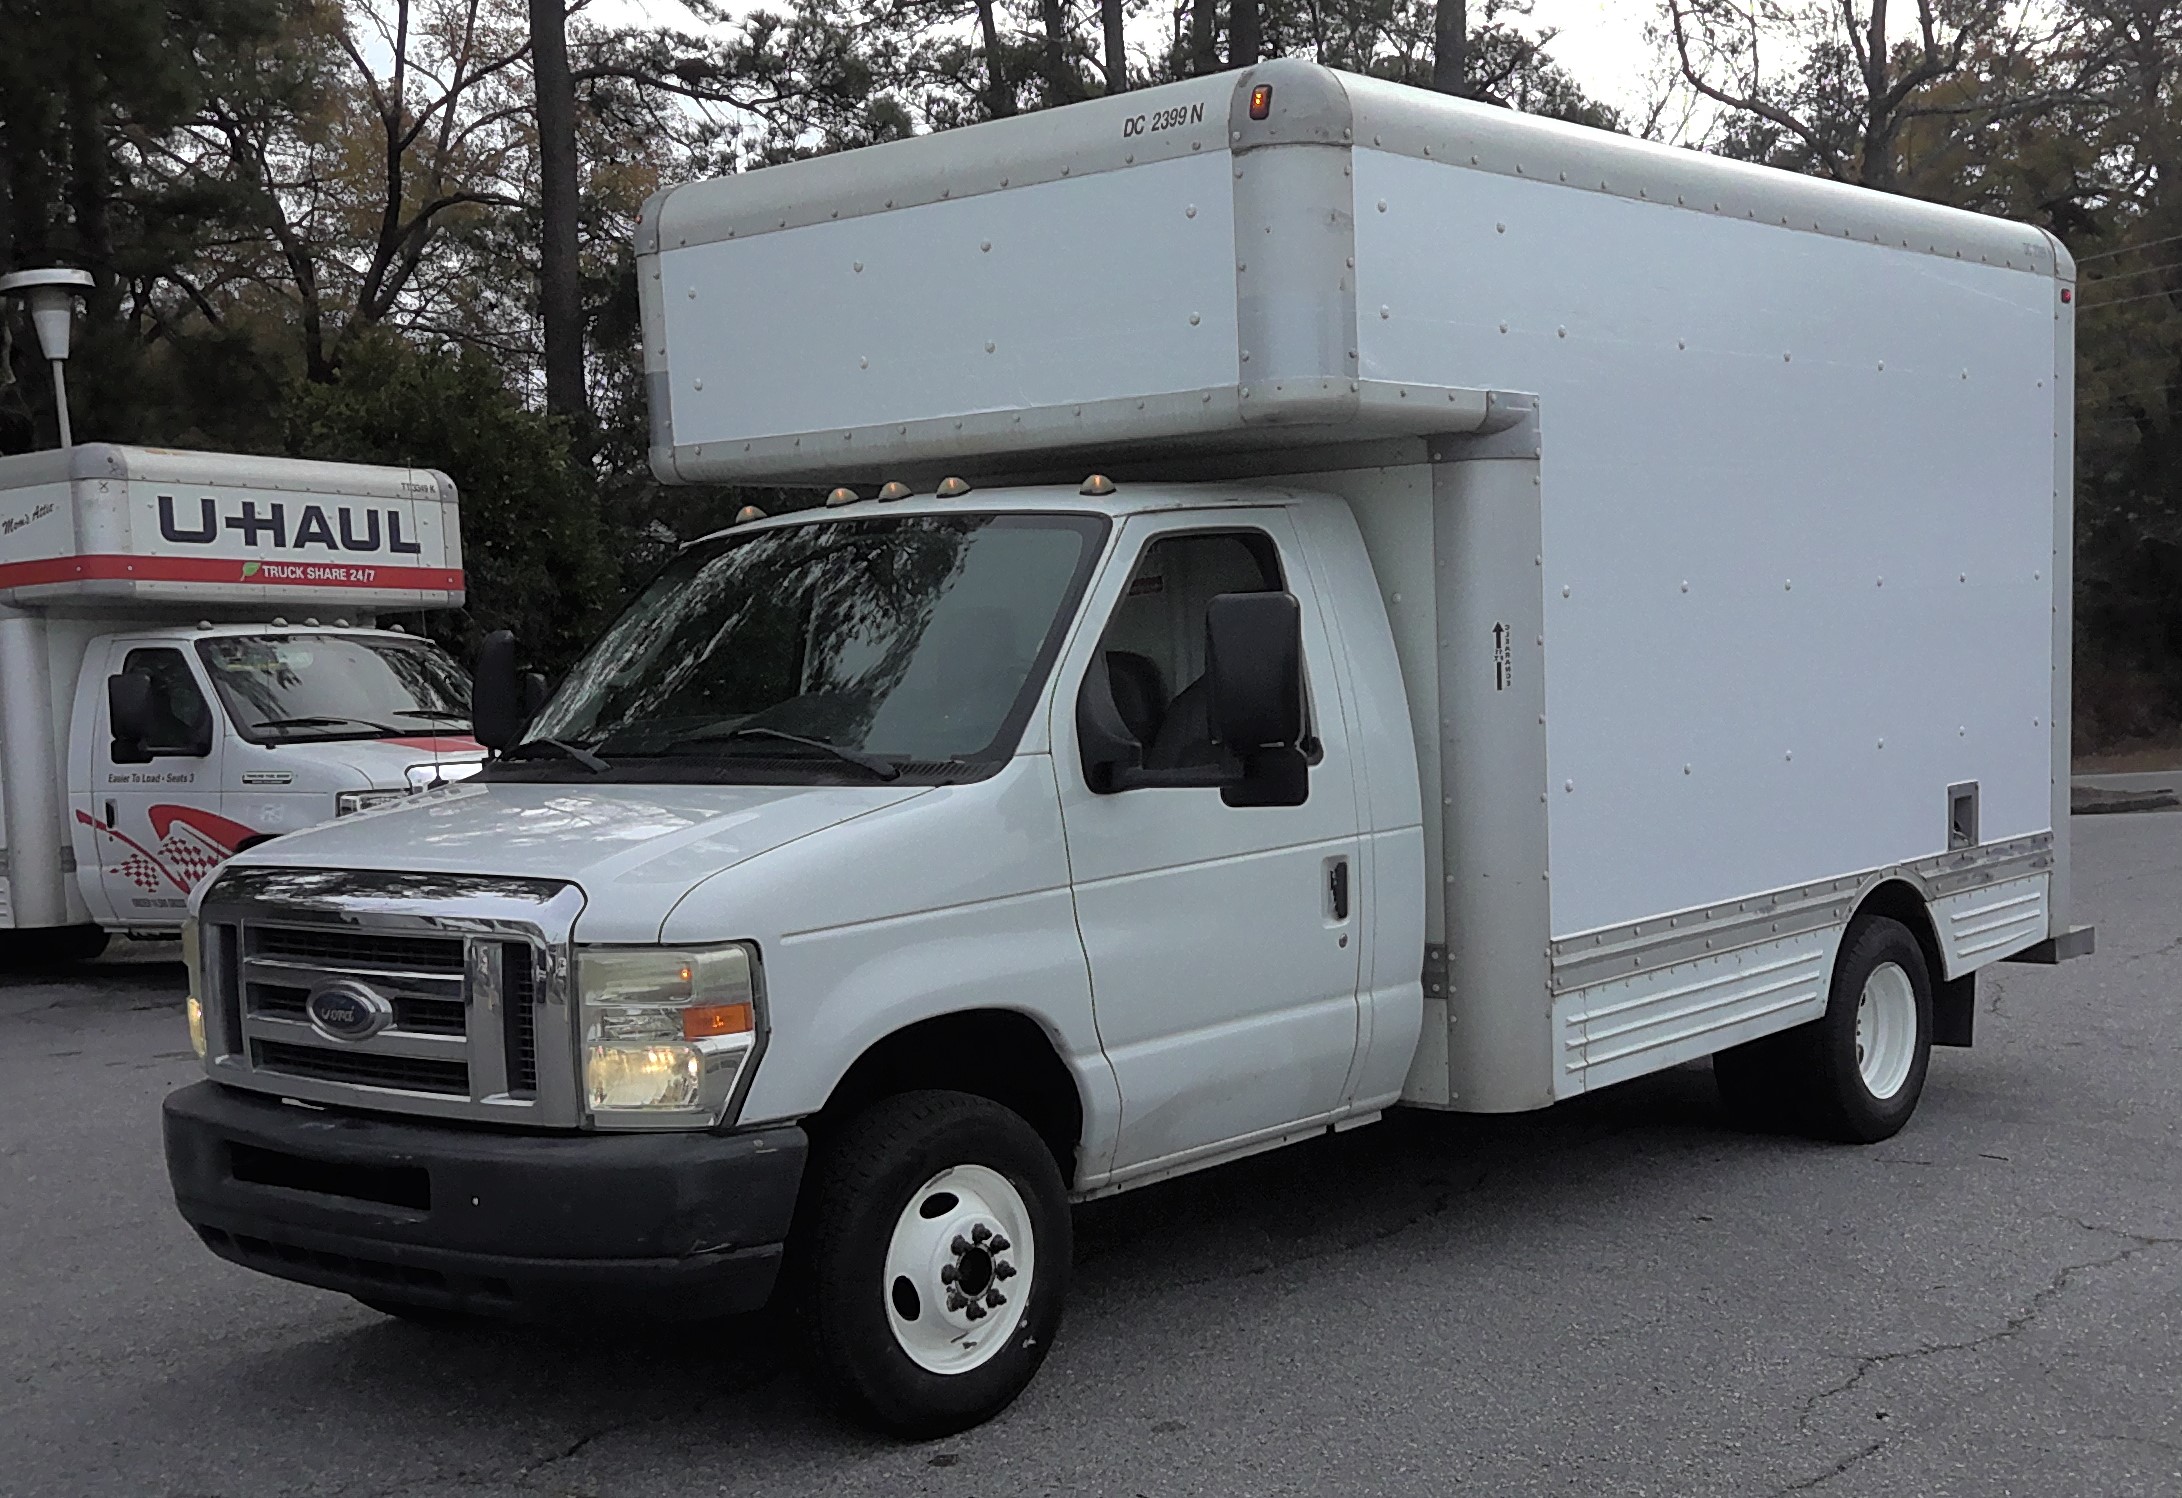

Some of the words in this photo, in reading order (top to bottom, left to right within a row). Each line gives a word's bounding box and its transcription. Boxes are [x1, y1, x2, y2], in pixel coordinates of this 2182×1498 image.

[1123, 115, 1146, 138] DC
[1151, 106, 1187, 132] 2399
[1190, 102, 1204, 124] N
[157, 495, 422, 555] U-HAUL
[262, 565, 304, 578] TRUCK
[307, 568, 347, 581] SHARE
[350, 568, 375, 583] 24/7
[108, 773, 130, 783] Easier
[132, 773, 140, 783] To
[142, 774, 161, 783] Load
[167, 773, 188, 783] Seats
[189, 773, 195, 783] 3
